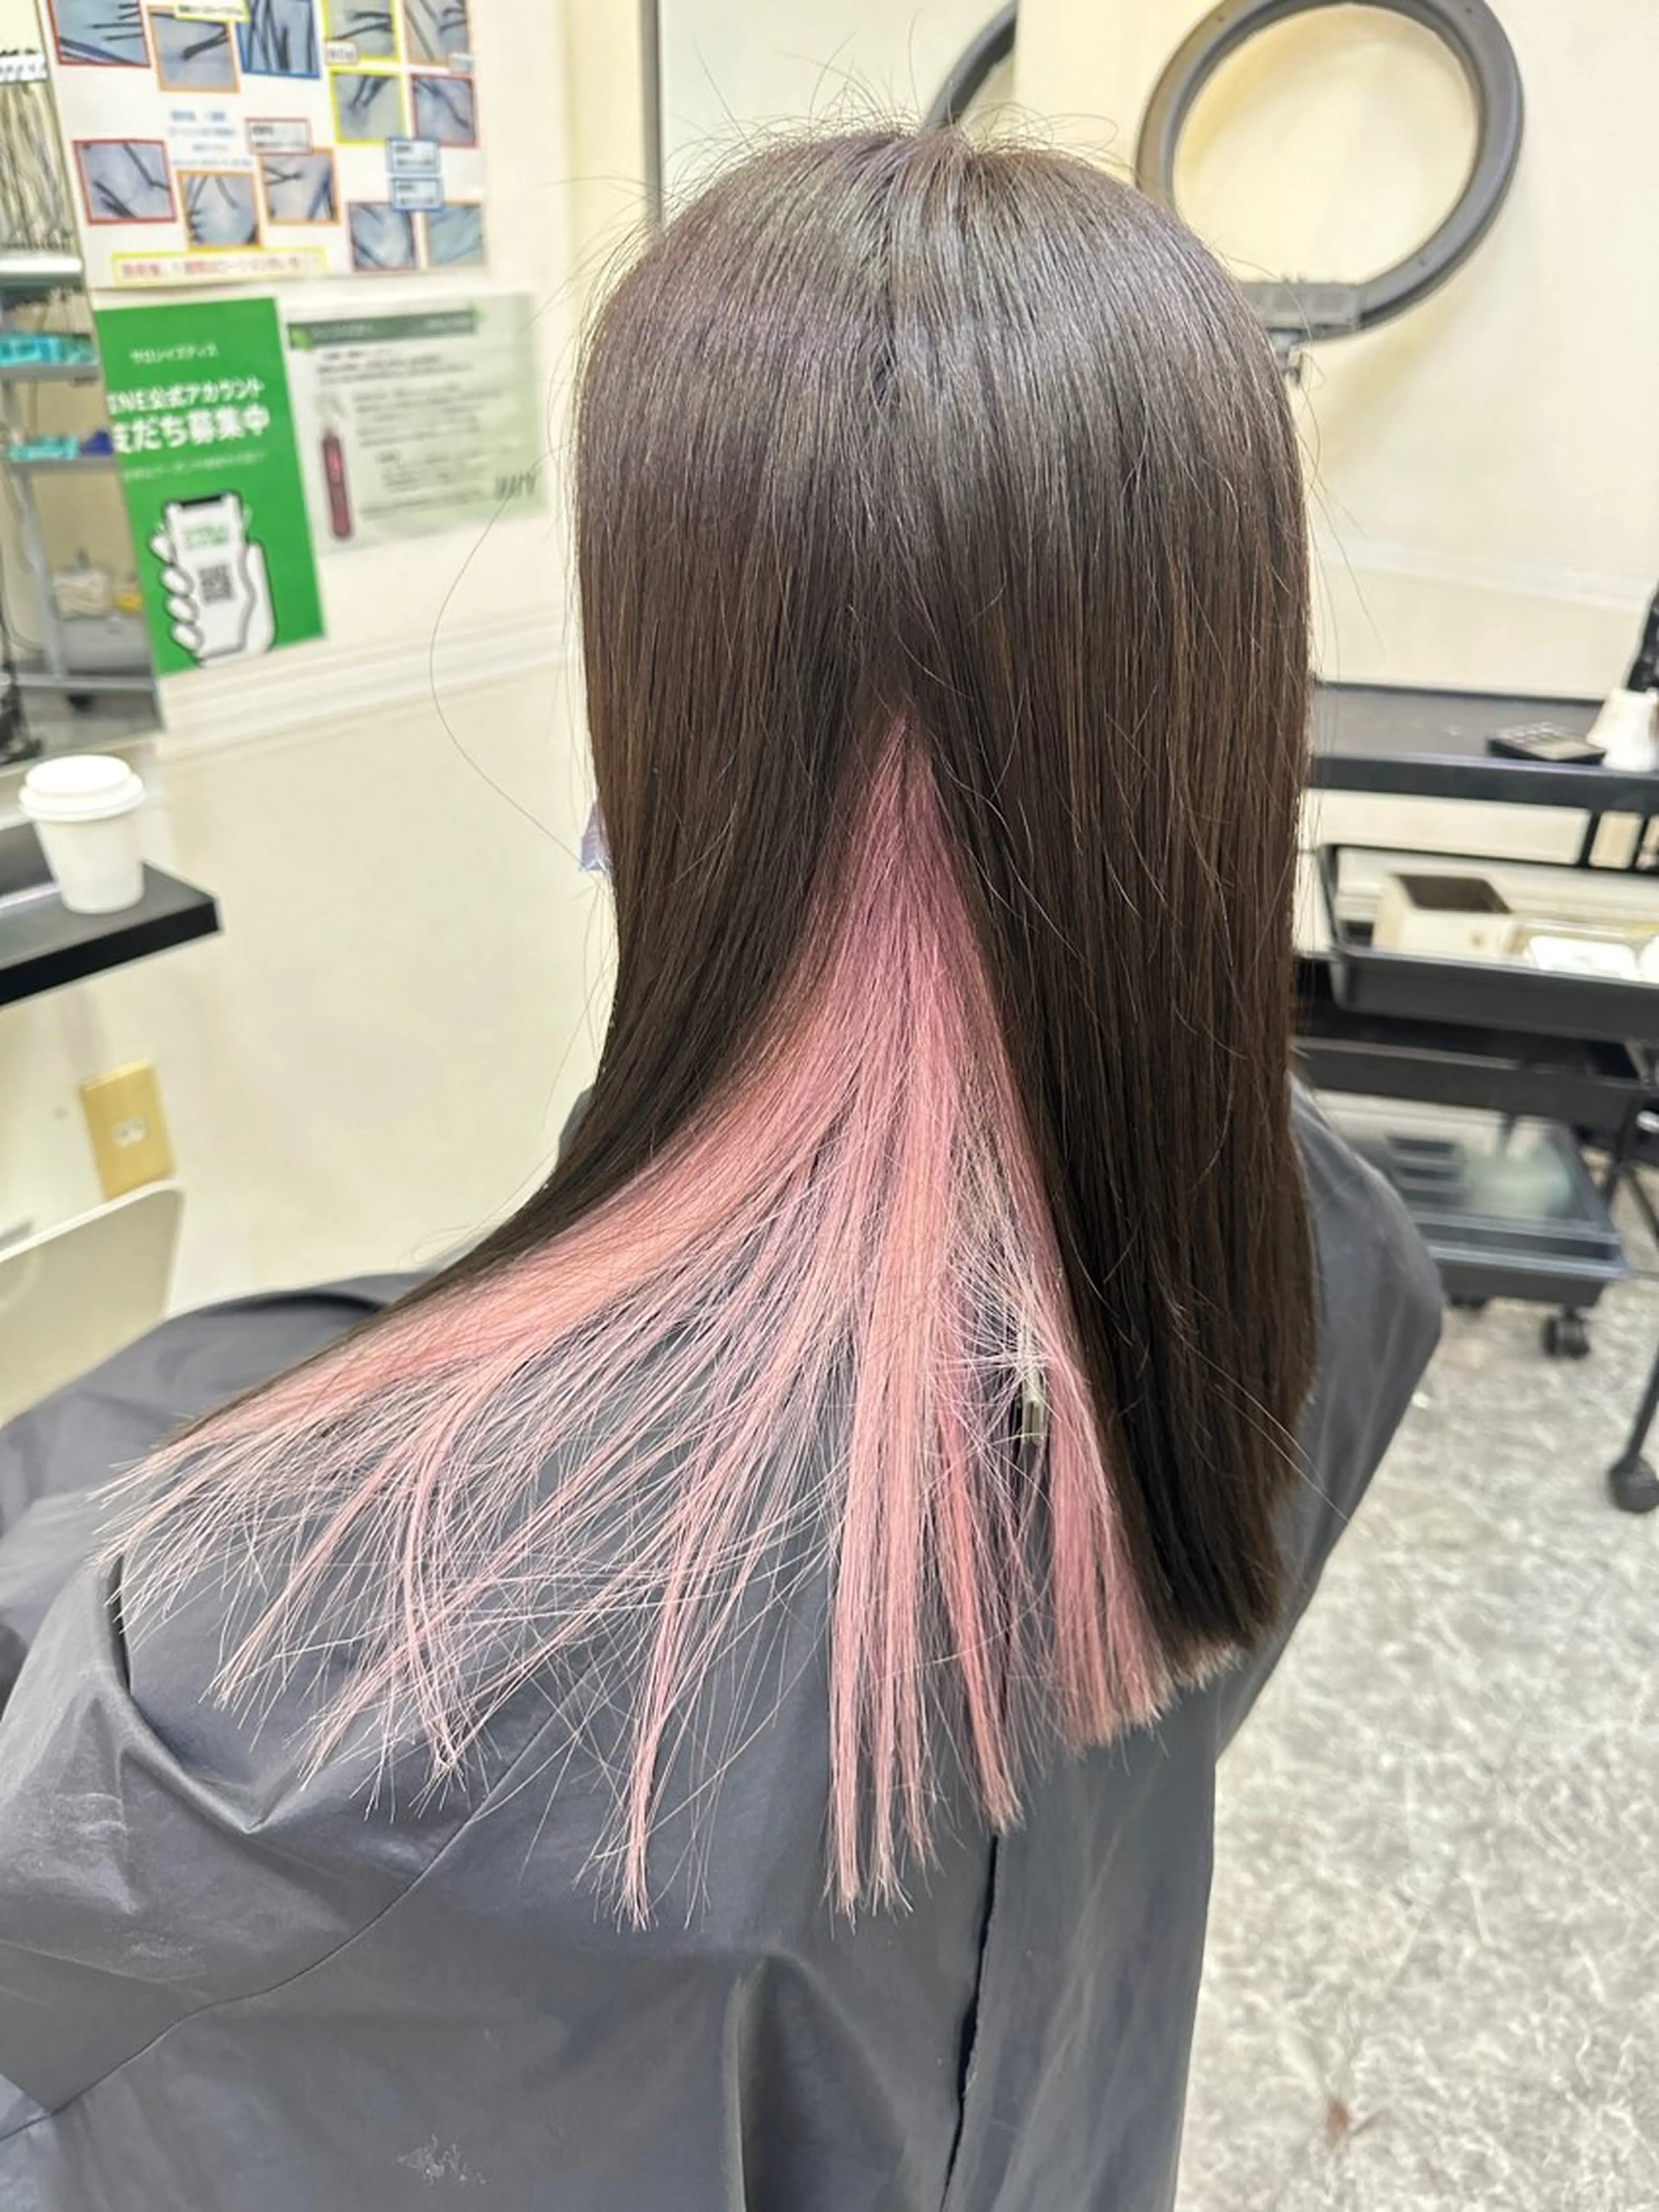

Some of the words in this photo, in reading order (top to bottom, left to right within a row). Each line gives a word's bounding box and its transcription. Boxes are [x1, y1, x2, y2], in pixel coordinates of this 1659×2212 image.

[107, 375, 264, 415] INE公式アカウント
